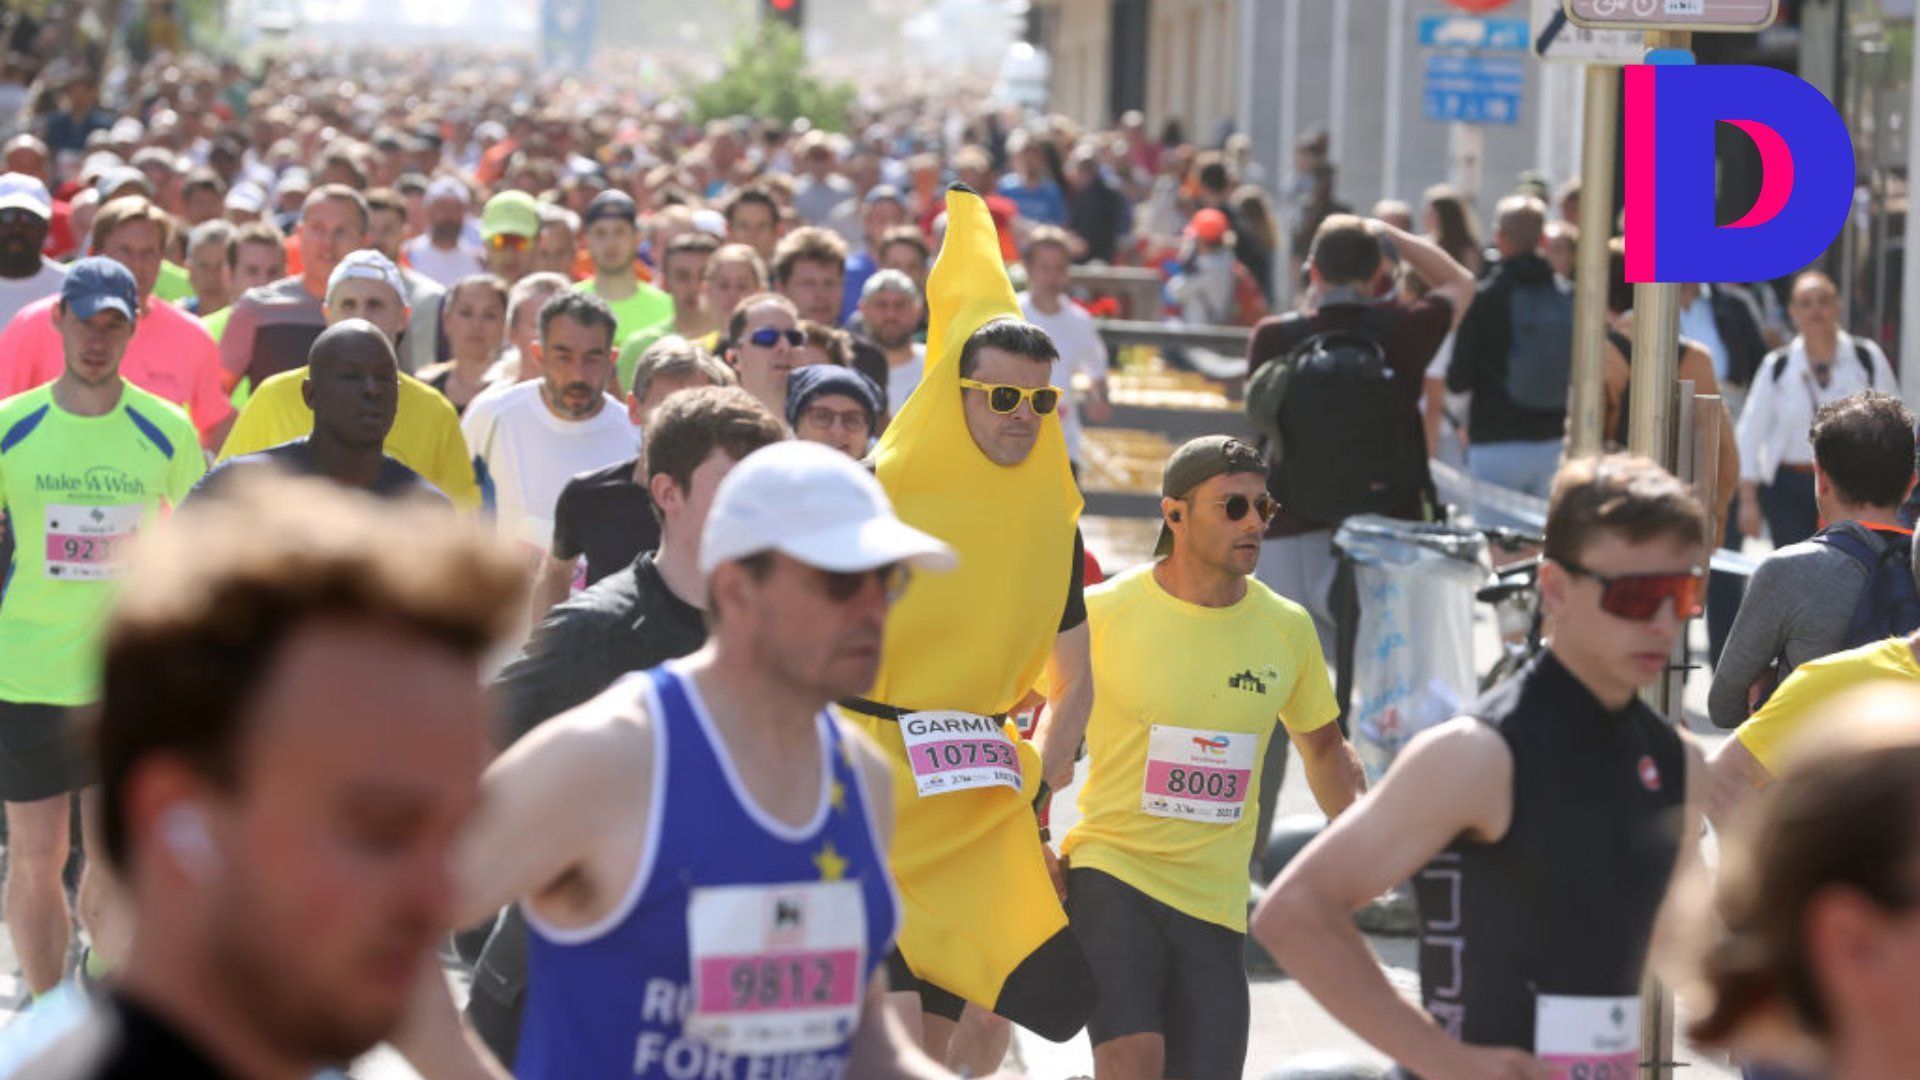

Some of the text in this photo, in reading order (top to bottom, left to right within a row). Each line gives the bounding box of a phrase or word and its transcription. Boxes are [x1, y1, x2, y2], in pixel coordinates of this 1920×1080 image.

[36, 474, 81, 491] Make
[103, 472, 145, 496] Wish
[925, 743, 1013, 769] 10753
[1167, 768, 1237, 798] 8003
[730, 958, 835, 1008] 9812
